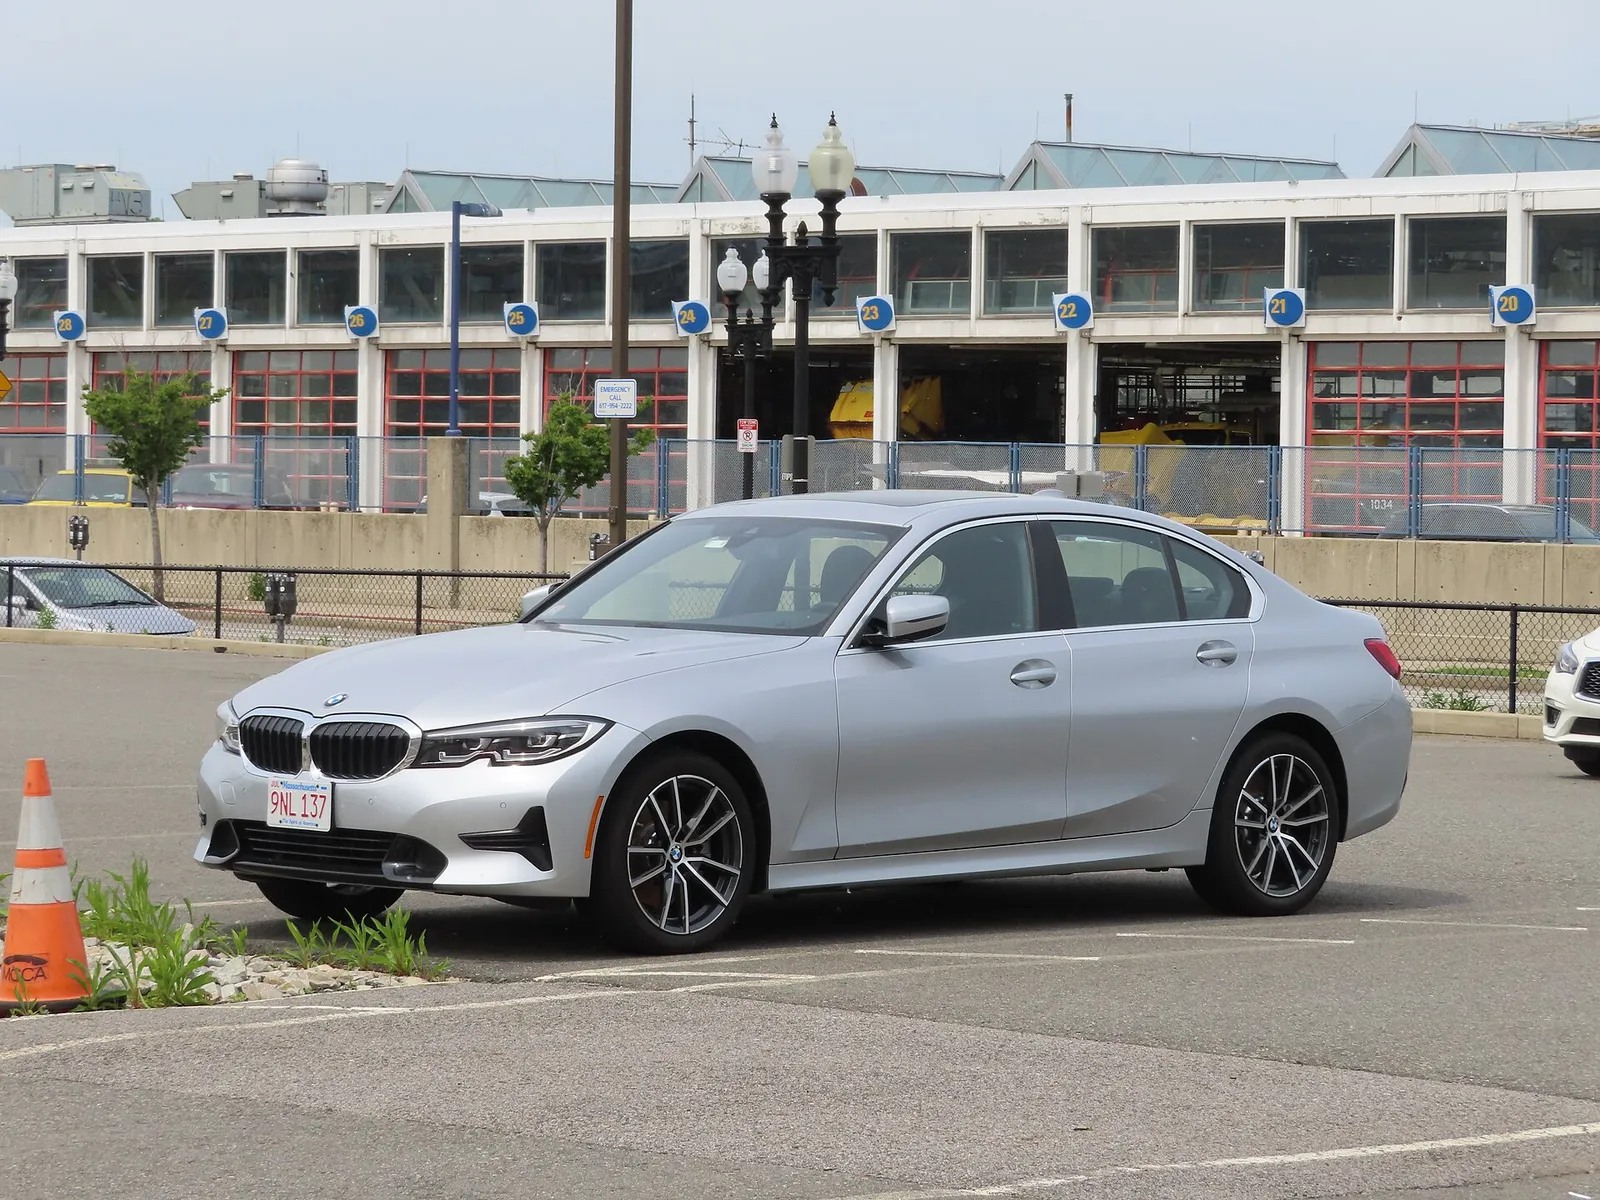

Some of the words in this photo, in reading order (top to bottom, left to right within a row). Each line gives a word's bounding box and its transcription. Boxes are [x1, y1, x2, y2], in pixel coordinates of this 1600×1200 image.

[1059, 303, 1078, 319] 22
[1271, 299, 1287, 314] 21
[1500, 296, 1518, 312] 20
[509, 311, 525, 325] 25
[679, 309, 697, 325] 24
[862, 305, 879, 321] 23
[59, 319, 72, 331] 28
[200, 317, 212, 330] 27
[349, 314, 364, 328] 26
[1370, 499, 1394, 510] 1034
[282, 781, 317, 791] Massachusetts
[271, 791, 297, 817] 9NL
[301, 793, 327, 819] 137
